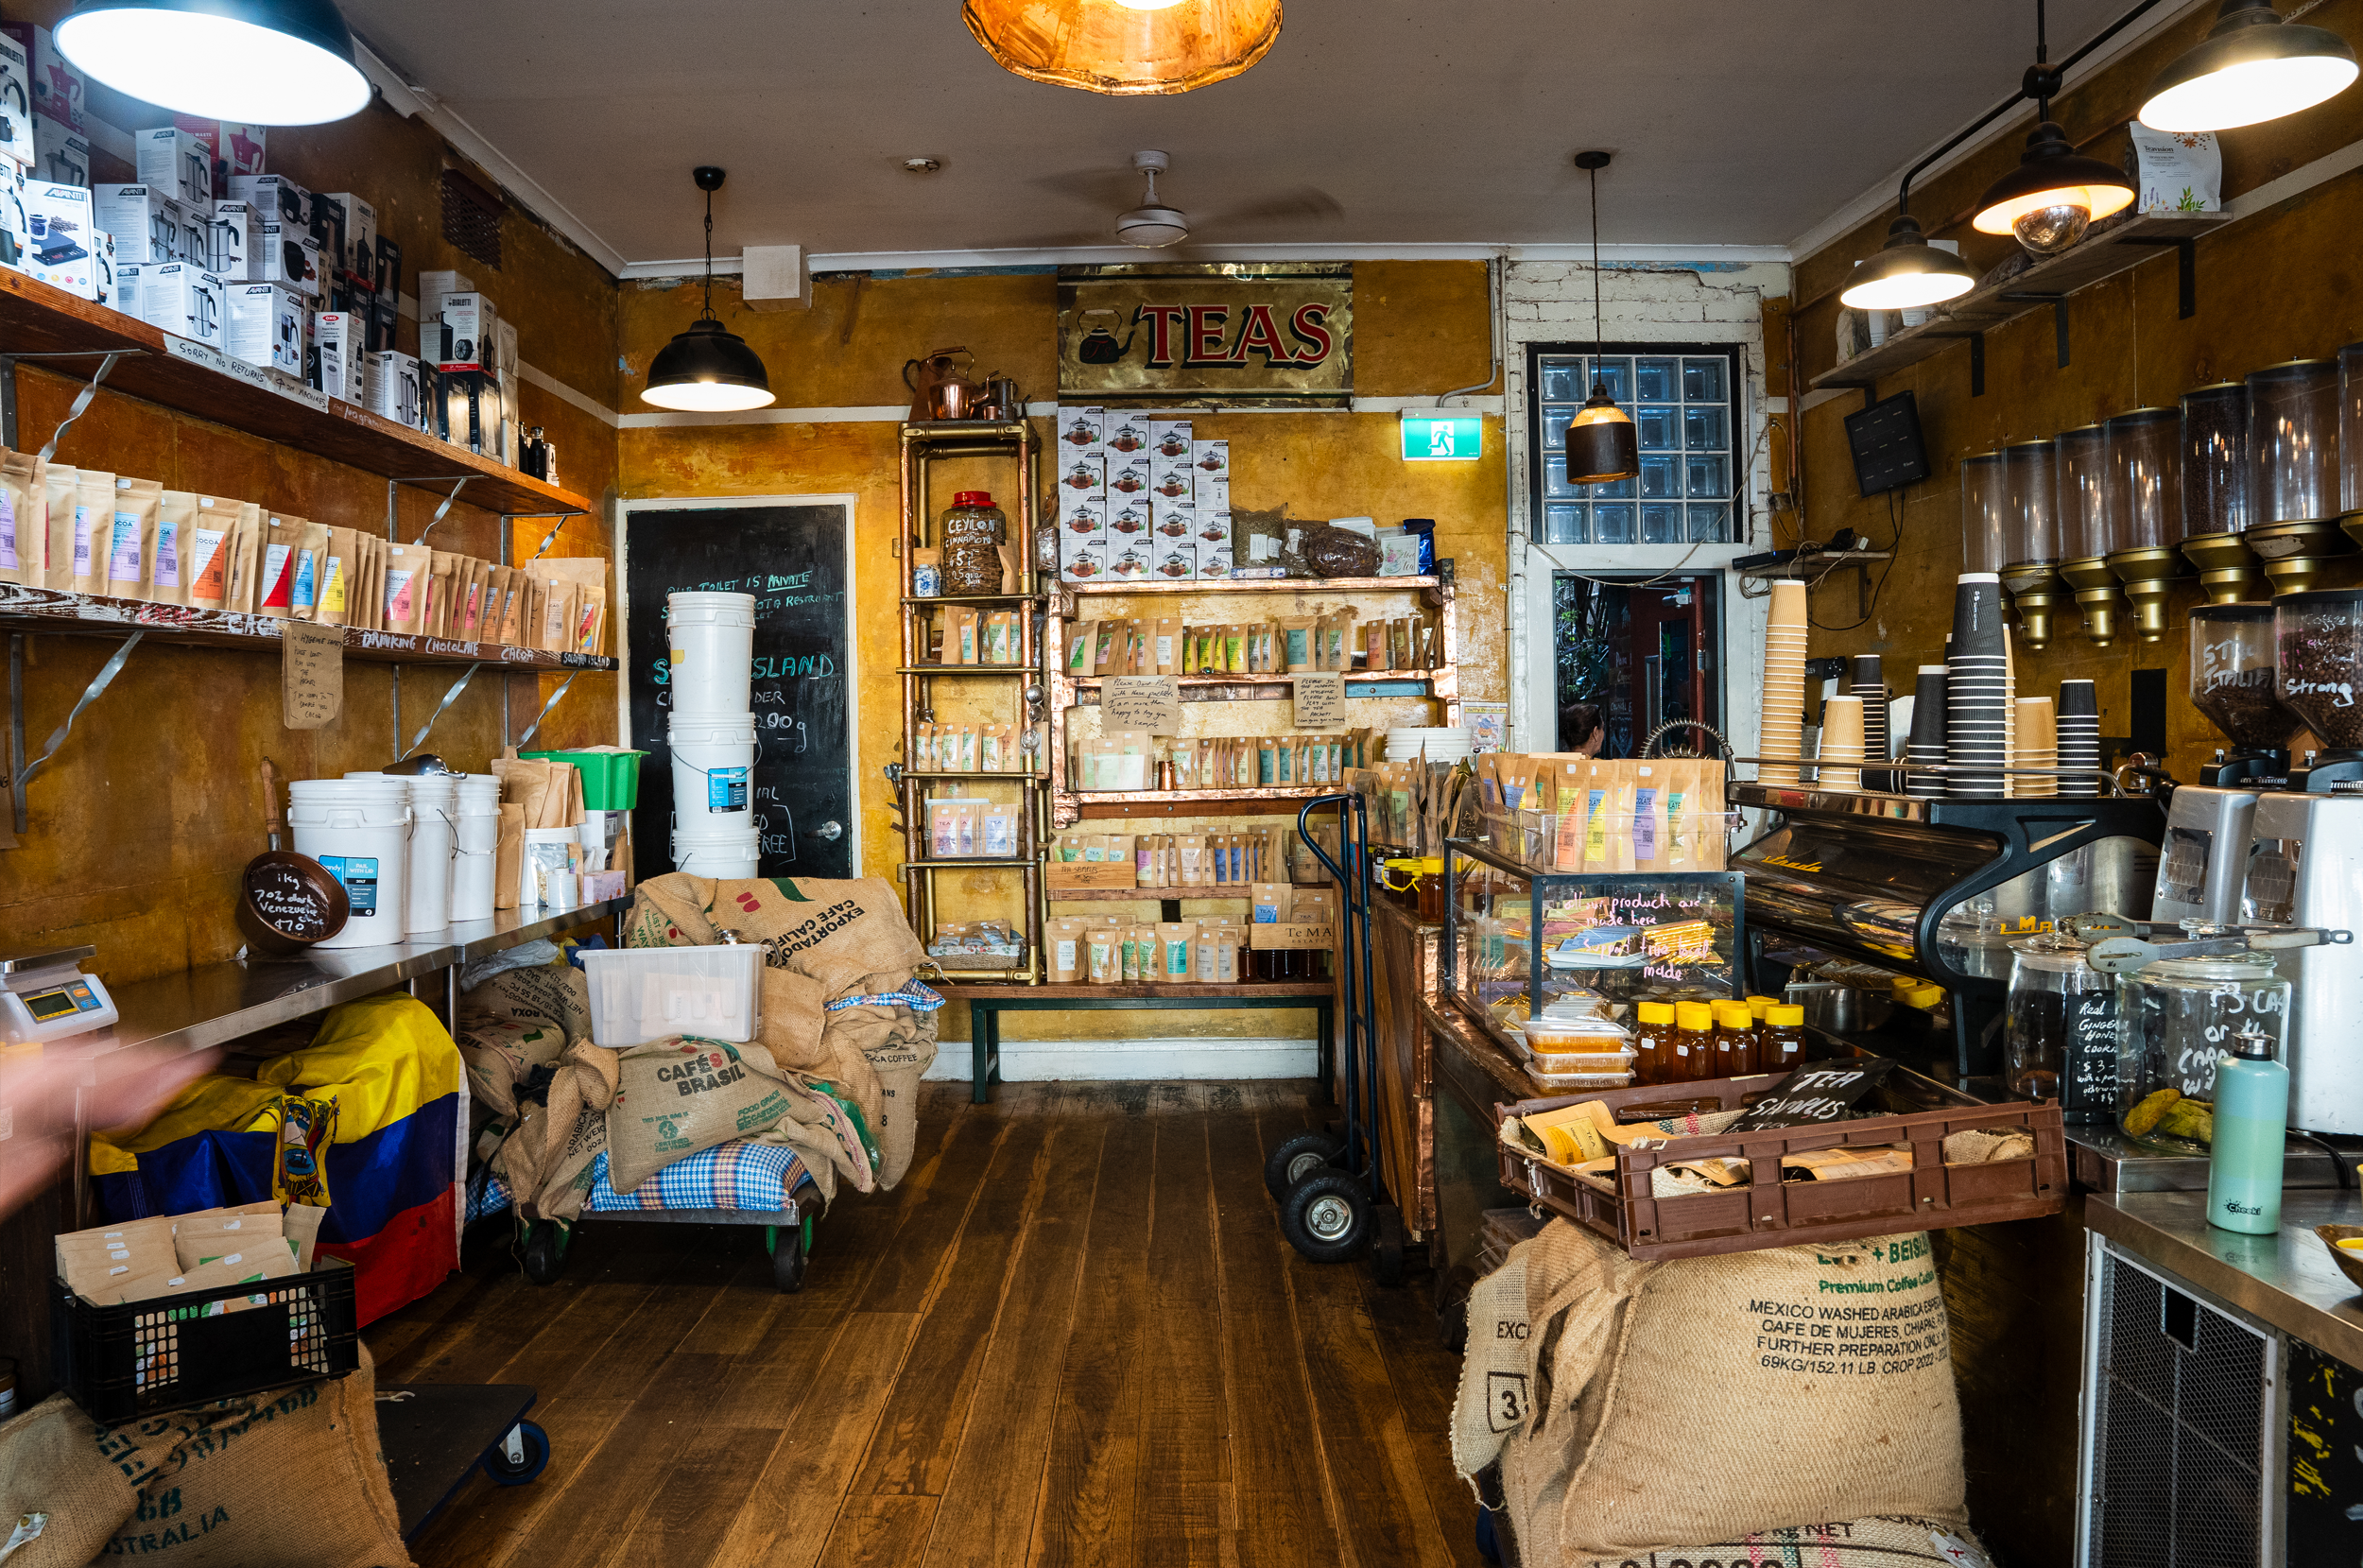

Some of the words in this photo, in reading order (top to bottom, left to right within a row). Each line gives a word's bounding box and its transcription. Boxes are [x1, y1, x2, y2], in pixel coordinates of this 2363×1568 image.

[153, 130, 175, 139] AVANTI
[44, 188, 86, 202] AVANTI
[160, 265, 181, 274] AVANTI
[201, 273, 218, 284] AVANTI
[452, 298, 471, 306] BIALETTI
[1138, 302, 1333, 369] TEAS
[180, 342, 208, 361] SORRY
[216, 357, 226, 367] NO
[232, 361, 265, 383] RETURNS
[948, 518, 996, 533] CEYLON
[945, 535, 992, 548] CINNAMON
[699, 579, 739, 592] TOILET
[747, 576, 760, 588] IS
[768, 571, 813, 588] PRIVATE
[362, 631, 416, 650] DRINKING
[425, 637, 478, 656] CHOCOLATE
[2285, 679, 2355, 707] Strong
[1108, 700, 1115, 709] I
[1112, 709, 1131, 719] happy
[1134, 720, 1159, 730] sample
[1762, 854, 1822, 873] strada
[287, 893, 317, 907] dark
[1612, 892, 1671, 915] products
[817, 900, 855, 922] CAFE
[1586, 911, 1623, 926] made
[1631, 910, 1657, 926] here
[274, 919, 304, 932] $70
[777, 919, 817, 947] CALIF
[1285, 928, 1302, 938] Te
[1306, 927, 1332, 938] MA
[1583, 935, 1630, 960] Support
[1679, 936, 1709, 958] local
[526, 970, 541, 983] BAG
[1644, 962, 1682, 981] made
[511, 1008, 541, 1017] ROXA
[569, 1001, 584, 1015] NET
[2079, 1000, 2104, 1015] Real
[2085, 1030, 2116, 1042] HONE
[2204, 1025, 2229, 1042] or
[888, 1053, 919, 1063] COFFEE
[2097, 1060, 2106, 1073] 3
[677, 1064, 747, 1096] BRASIL
[1791, 1071, 1865, 1093] TEA
[2078, 1074, 2094, 1083] with
[737, 1104, 760, 1117] FOOD
[760, 1089, 781, 1109] GRADE
[1748, 1097, 1846, 1119] SAMPLES
[567, 1111, 588, 1151] ARABICA
[1586, 1131, 1595, 1147] TEA
[569, 1140, 584, 1159] NET
[583, 1124, 606, 1142] WEIG
[2227, 1201, 2261, 1215] Cheeki
[1819, 1280, 1885, 1294] Premium
[1887, 1276, 1918, 1293] Coffee
[1751, 1299, 1815, 1319] MEXICO
[1819, 1306, 1879, 1321] WASHED
[1882, 1302, 1923, 1321] ARABICA
[1497, 1321, 1531, 1340] EXC
[1762, 1319, 1805, 1334] CAFE
[1811, 1324, 1832, 1338] DE
[1836, 1325, 1902, 1340] MUJERES,
[1757, 1336, 1835, 1356] FURTHER
[1837, 1338, 1923, 1357] PREPARATION
[1762, 1355, 1854, 1375] 69KG/152.11
[1883, 1357, 1914, 1374] CROP
[1916, 1352, 1934, 1370] 2022
[102, 1505, 230, 1556] USTRALIA
